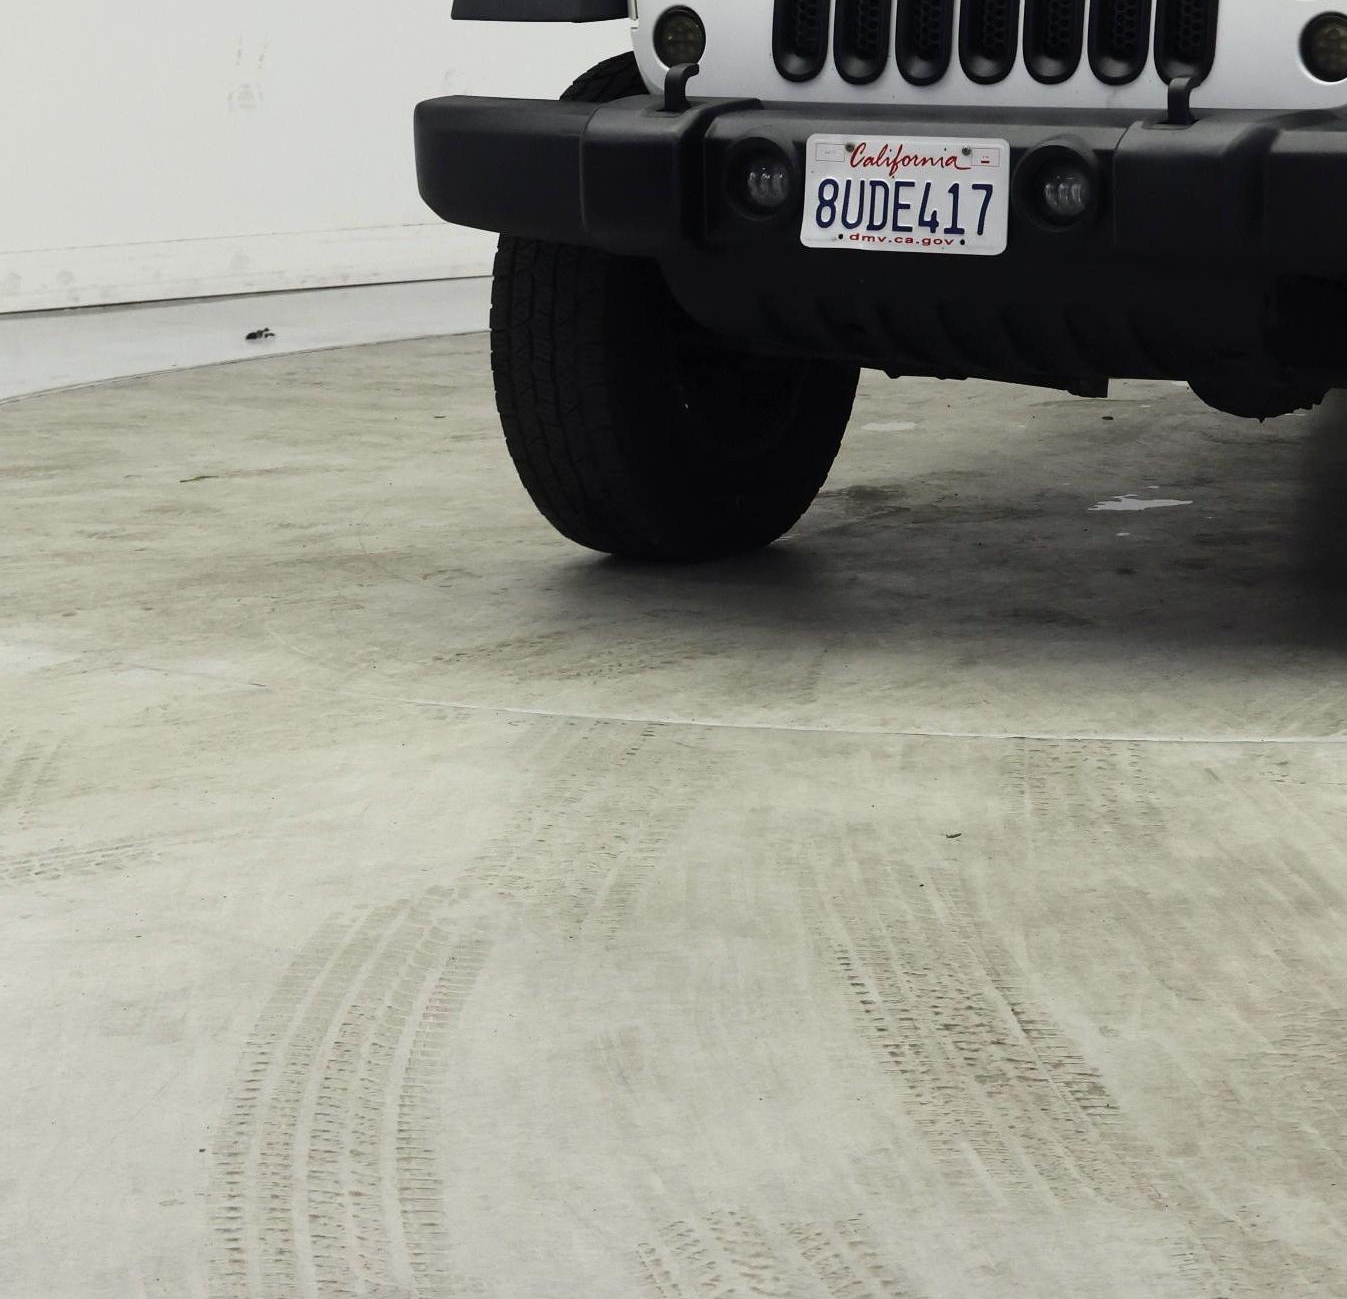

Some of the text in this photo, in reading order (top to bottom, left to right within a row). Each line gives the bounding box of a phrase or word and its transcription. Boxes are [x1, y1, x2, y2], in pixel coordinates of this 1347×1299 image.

[849, 142, 971, 177] California
[815, 178, 994, 236] 8UDE417
[849, 232, 955, 246] dmv.ca.gov
